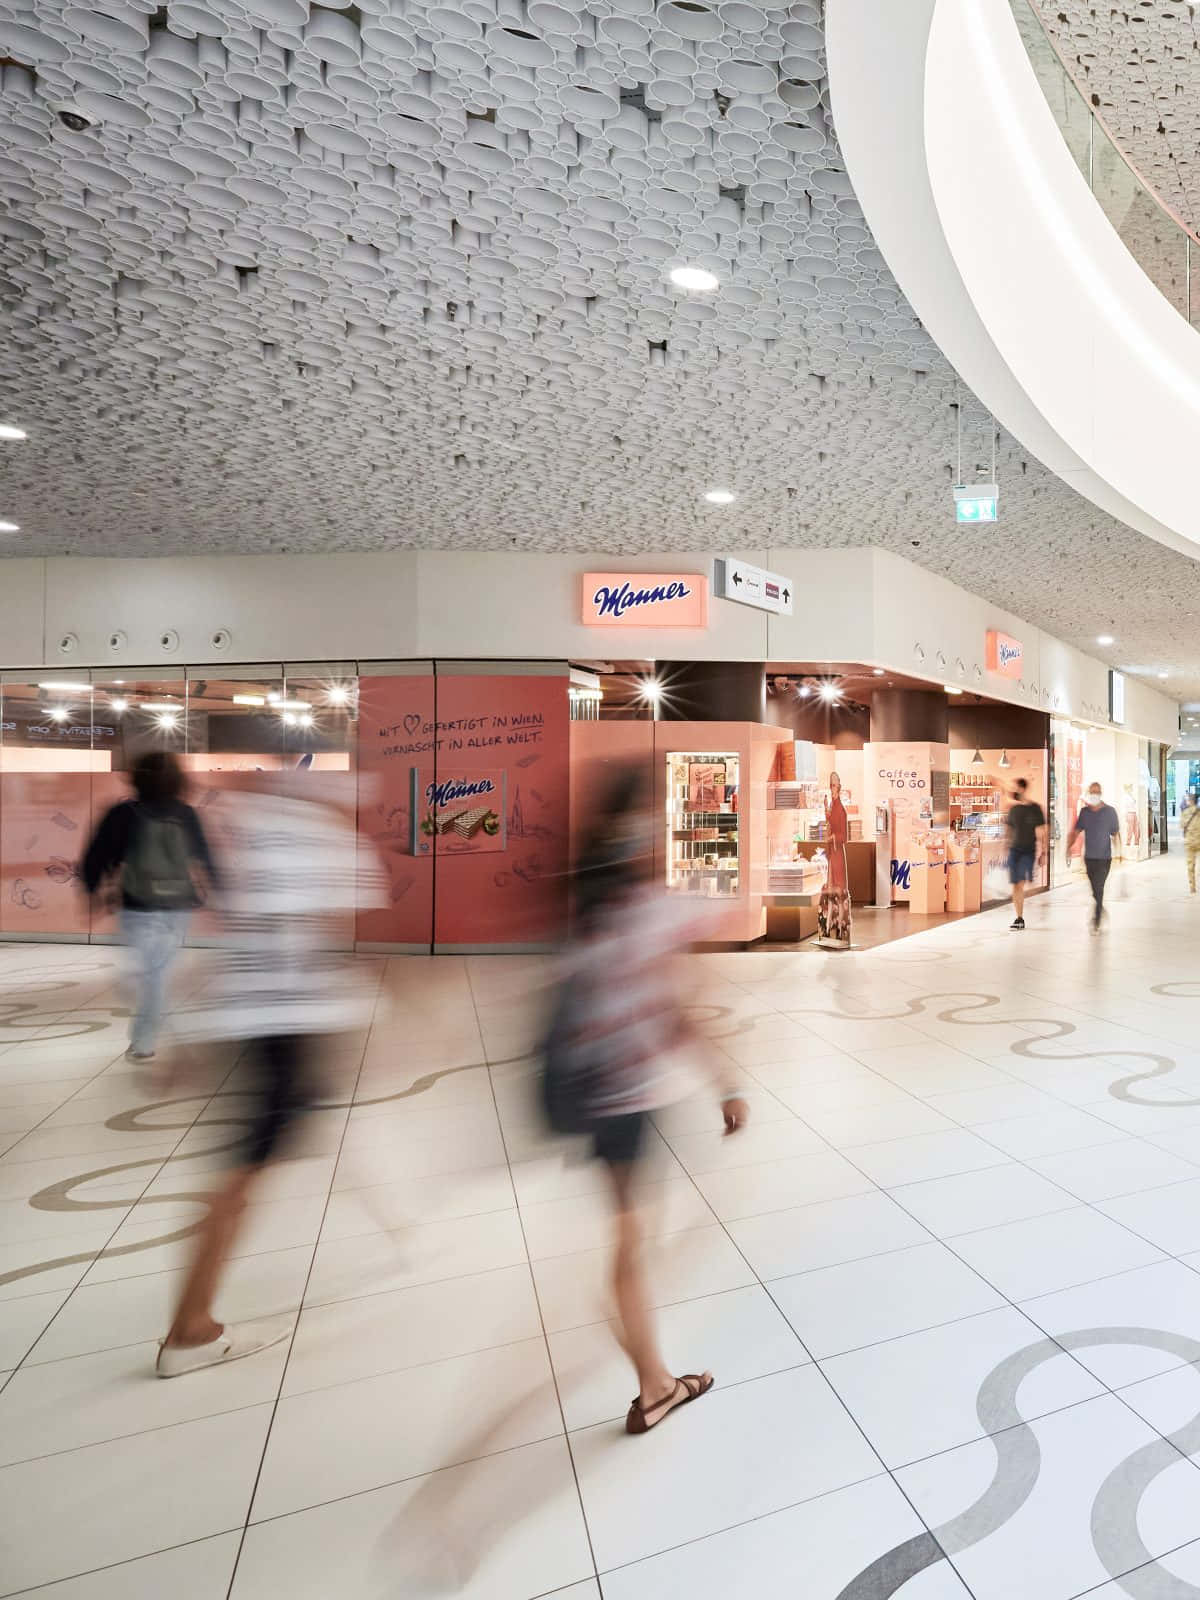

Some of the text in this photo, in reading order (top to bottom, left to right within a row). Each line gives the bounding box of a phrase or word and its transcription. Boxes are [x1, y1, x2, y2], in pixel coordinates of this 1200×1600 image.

[594, 582, 690, 616] Manner
[878, 769, 917, 778] Coffee
[889, 779, 926, 788] TO GO
[425, 779, 495, 807] Manner
